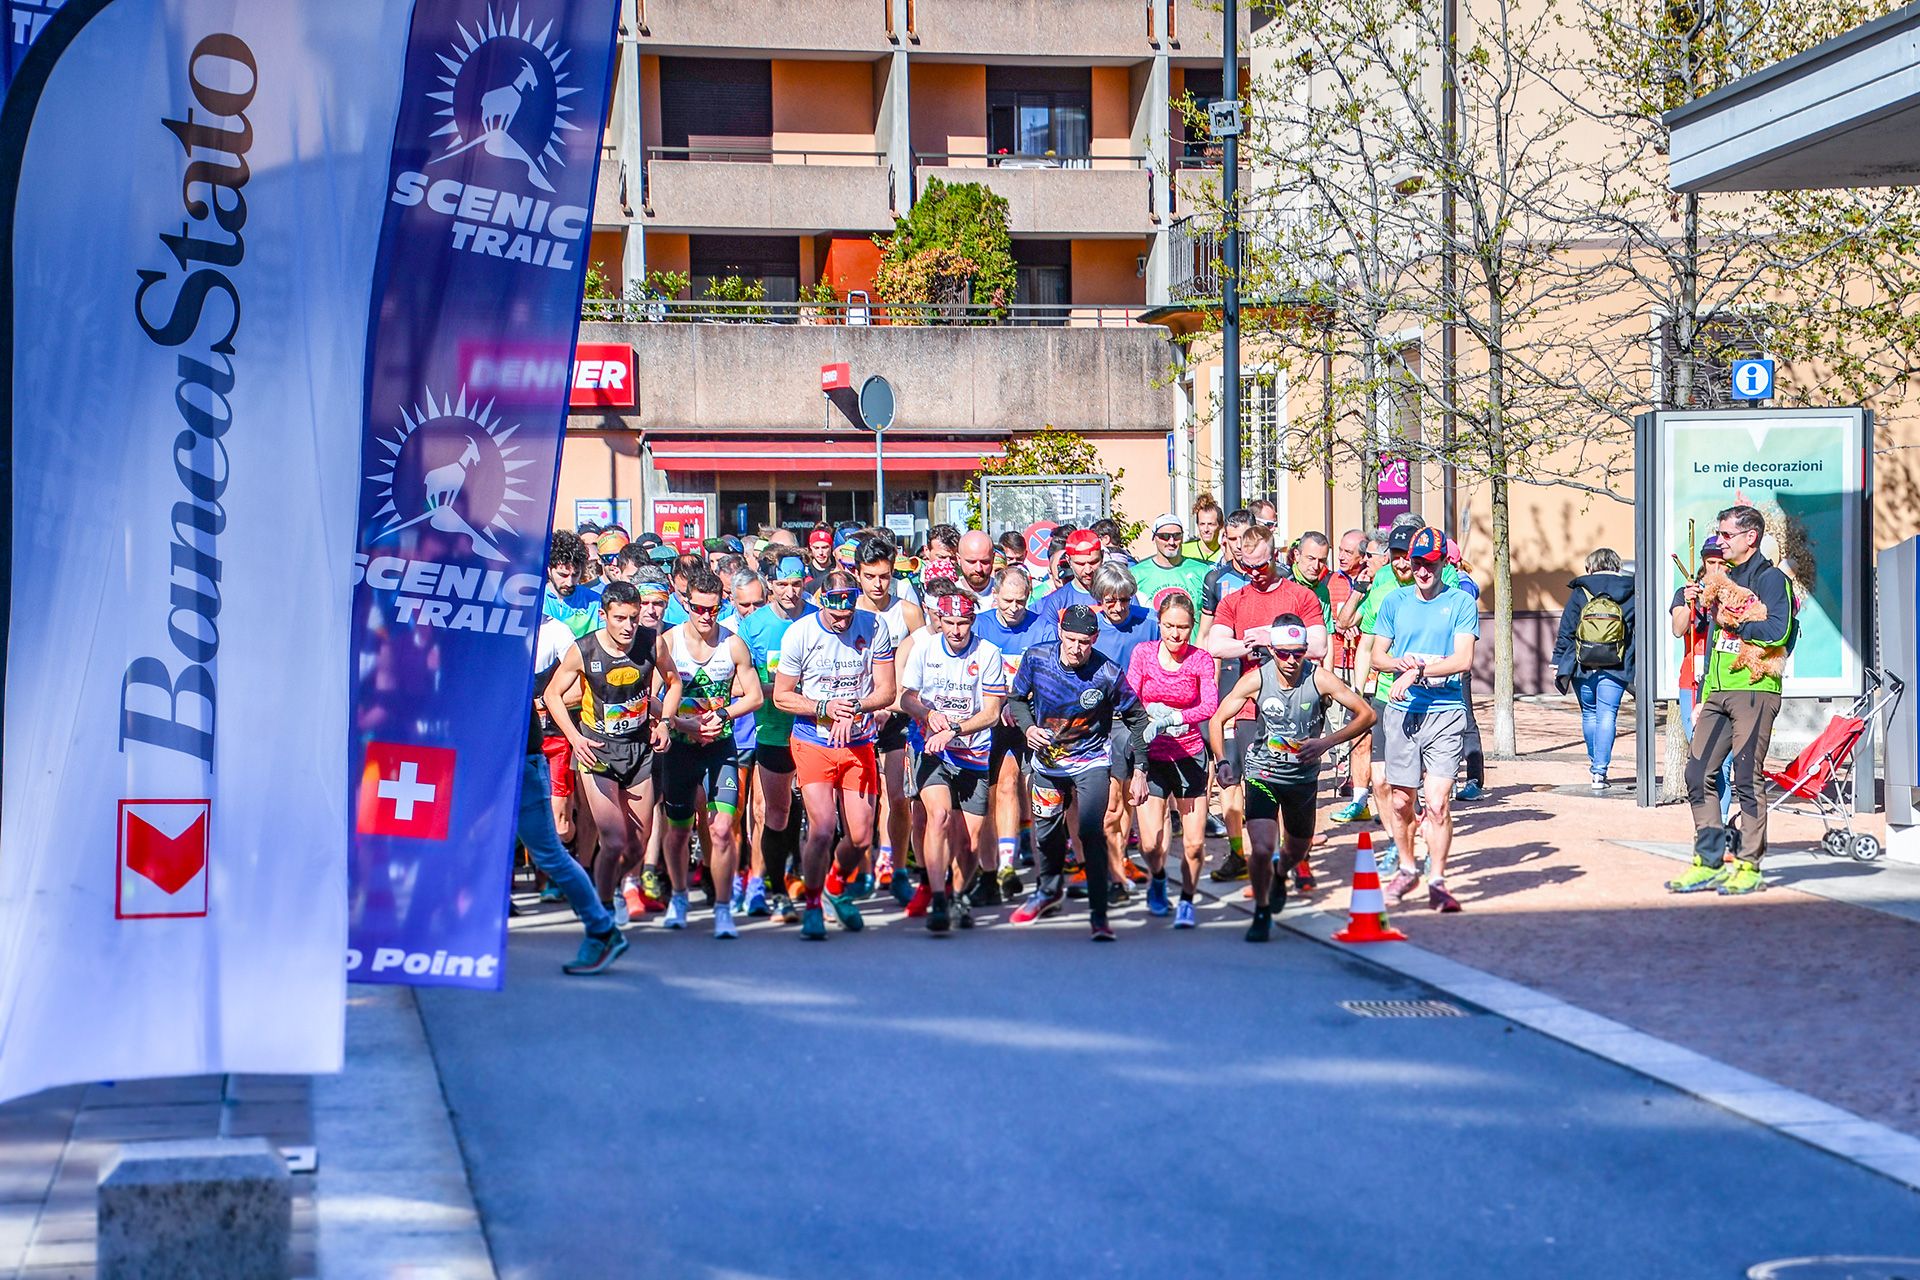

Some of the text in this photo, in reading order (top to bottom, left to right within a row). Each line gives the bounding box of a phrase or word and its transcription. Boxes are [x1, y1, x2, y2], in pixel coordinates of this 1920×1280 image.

[391, 171, 589, 240] SCENIC
[451, 221, 574, 271] TRAIL
[118, 33, 258, 774] BancaStato
[1694, 460, 1823, 473] Le mie decorazioni
[1723, 476, 1793, 490] di Pasqua.
[781, 521, 815, 529] DENNER
[394, 596, 529, 636] TRAIL
[832, 680, 858, 689] 2000
[942, 700, 968, 710] 2000
[612, 720, 629, 731] 49
[1274, 751, 1289, 761] 21
[371, 948, 499, 978] Point
